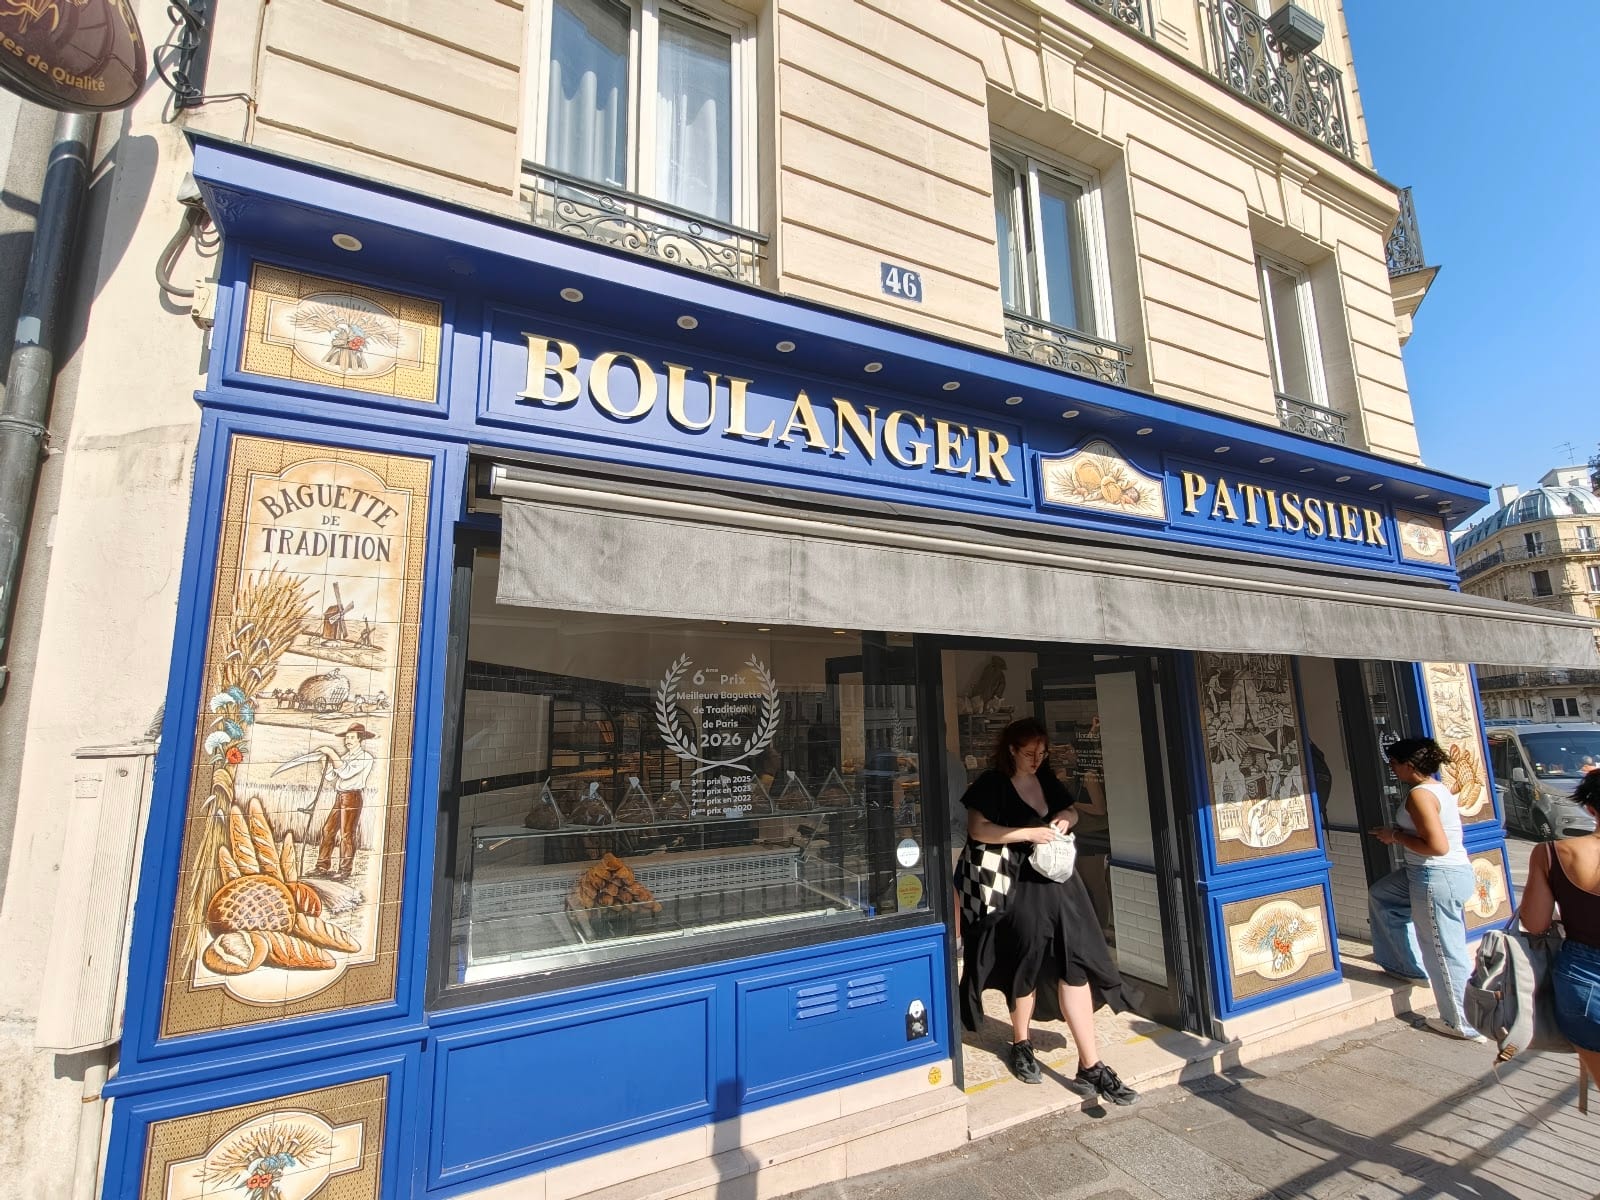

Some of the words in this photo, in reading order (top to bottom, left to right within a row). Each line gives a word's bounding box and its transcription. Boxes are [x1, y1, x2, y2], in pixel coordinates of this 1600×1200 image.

[0, 32, 24, 57] es
[27, 54, 49, 73] de
[52, 66, 105, 91] Qualité
[886, 267, 917, 297] 46
[516, 330, 1016, 483] BOULANGER
[258, 483, 399, 528] BAGUETTE
[1181, 470, 1388, 546] PATISSIER
[321, 515, 341, 526] DE
[262, 527, 392, 562] TRADITION
[720, 674, 746, 685] Prix
[676, 691, 719, 700] Meilleure
[720, 691, 762, 701] Baguette
[692, 705, 705, 714] de
[705, 704, 747, 714] Tradition
[703, 719, 714, 728] de
[716, 719, 739, 728] Paris
[701, 733, 742, 747] 2026
[706, 777, 722, 787] prix
[732, 775, 751, 783] 2025
[706, 787, 722, 797] prix
[706, 796, 722, 806] prix
[732, 794, 752, 802] 2022
[706, 806, 722, 816] prix
